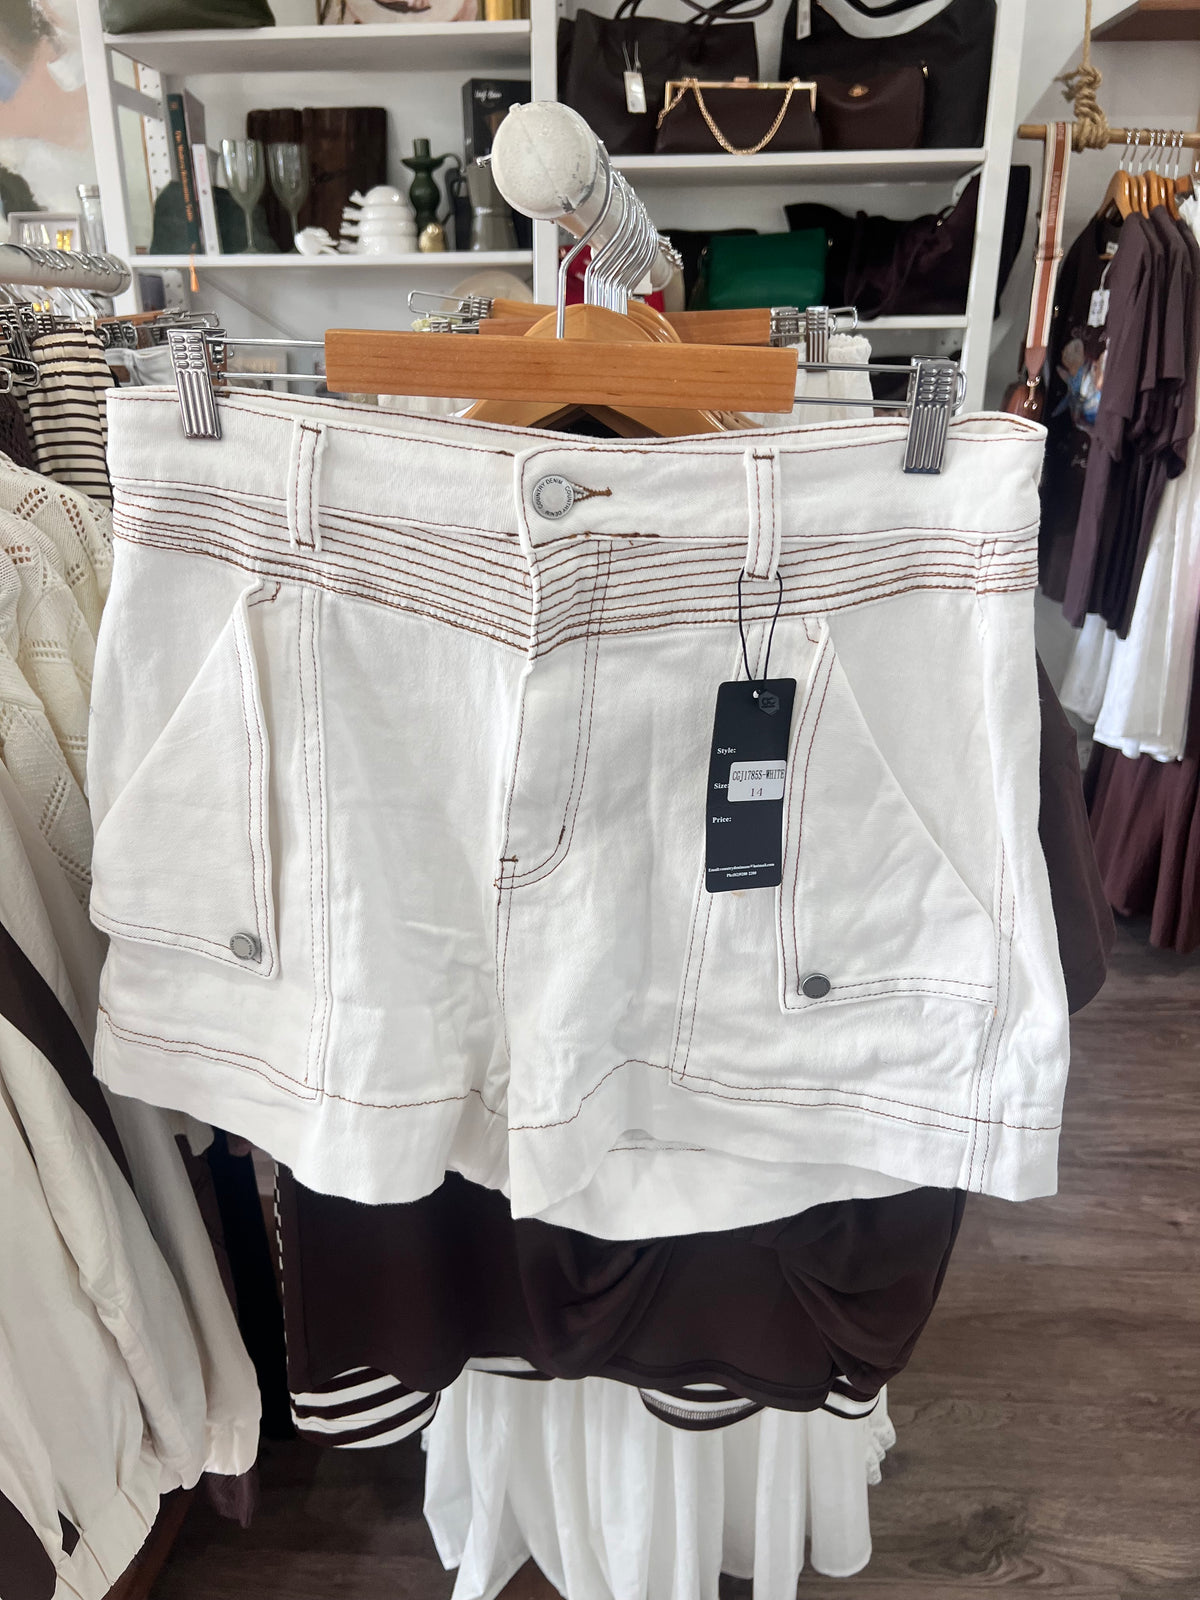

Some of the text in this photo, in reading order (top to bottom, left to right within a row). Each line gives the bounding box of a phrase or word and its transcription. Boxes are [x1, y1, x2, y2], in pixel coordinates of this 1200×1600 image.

[536, 482, 545, 509] COUNTRY
[563, 486, 572, 512] COUNTRY
[751, 788, 763, 797] 14
